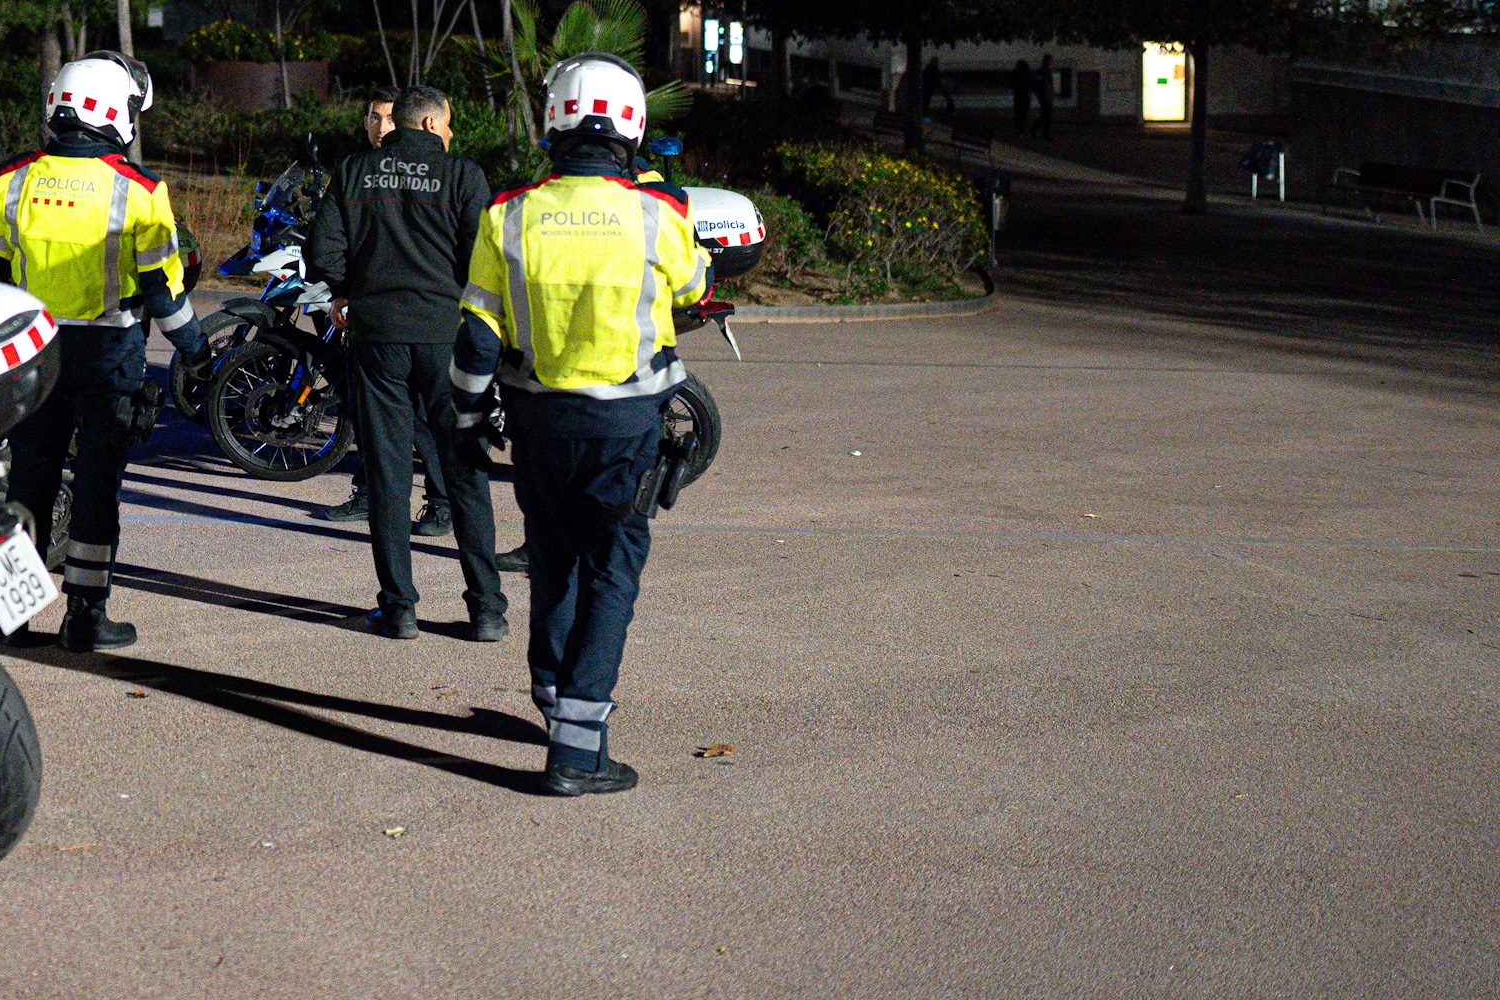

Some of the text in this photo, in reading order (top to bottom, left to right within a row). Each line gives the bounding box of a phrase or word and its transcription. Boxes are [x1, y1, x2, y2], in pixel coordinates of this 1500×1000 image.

[379, 157, 430, 176] Clece
[36, 177, 95, 193] POLICIA
[363, 173, 441, 193] SEGURIDAD
[540, 211, 621, 226] POLICIA
[709, 220, 746, 232] policia
[0, 573, 46, 621] 1939
